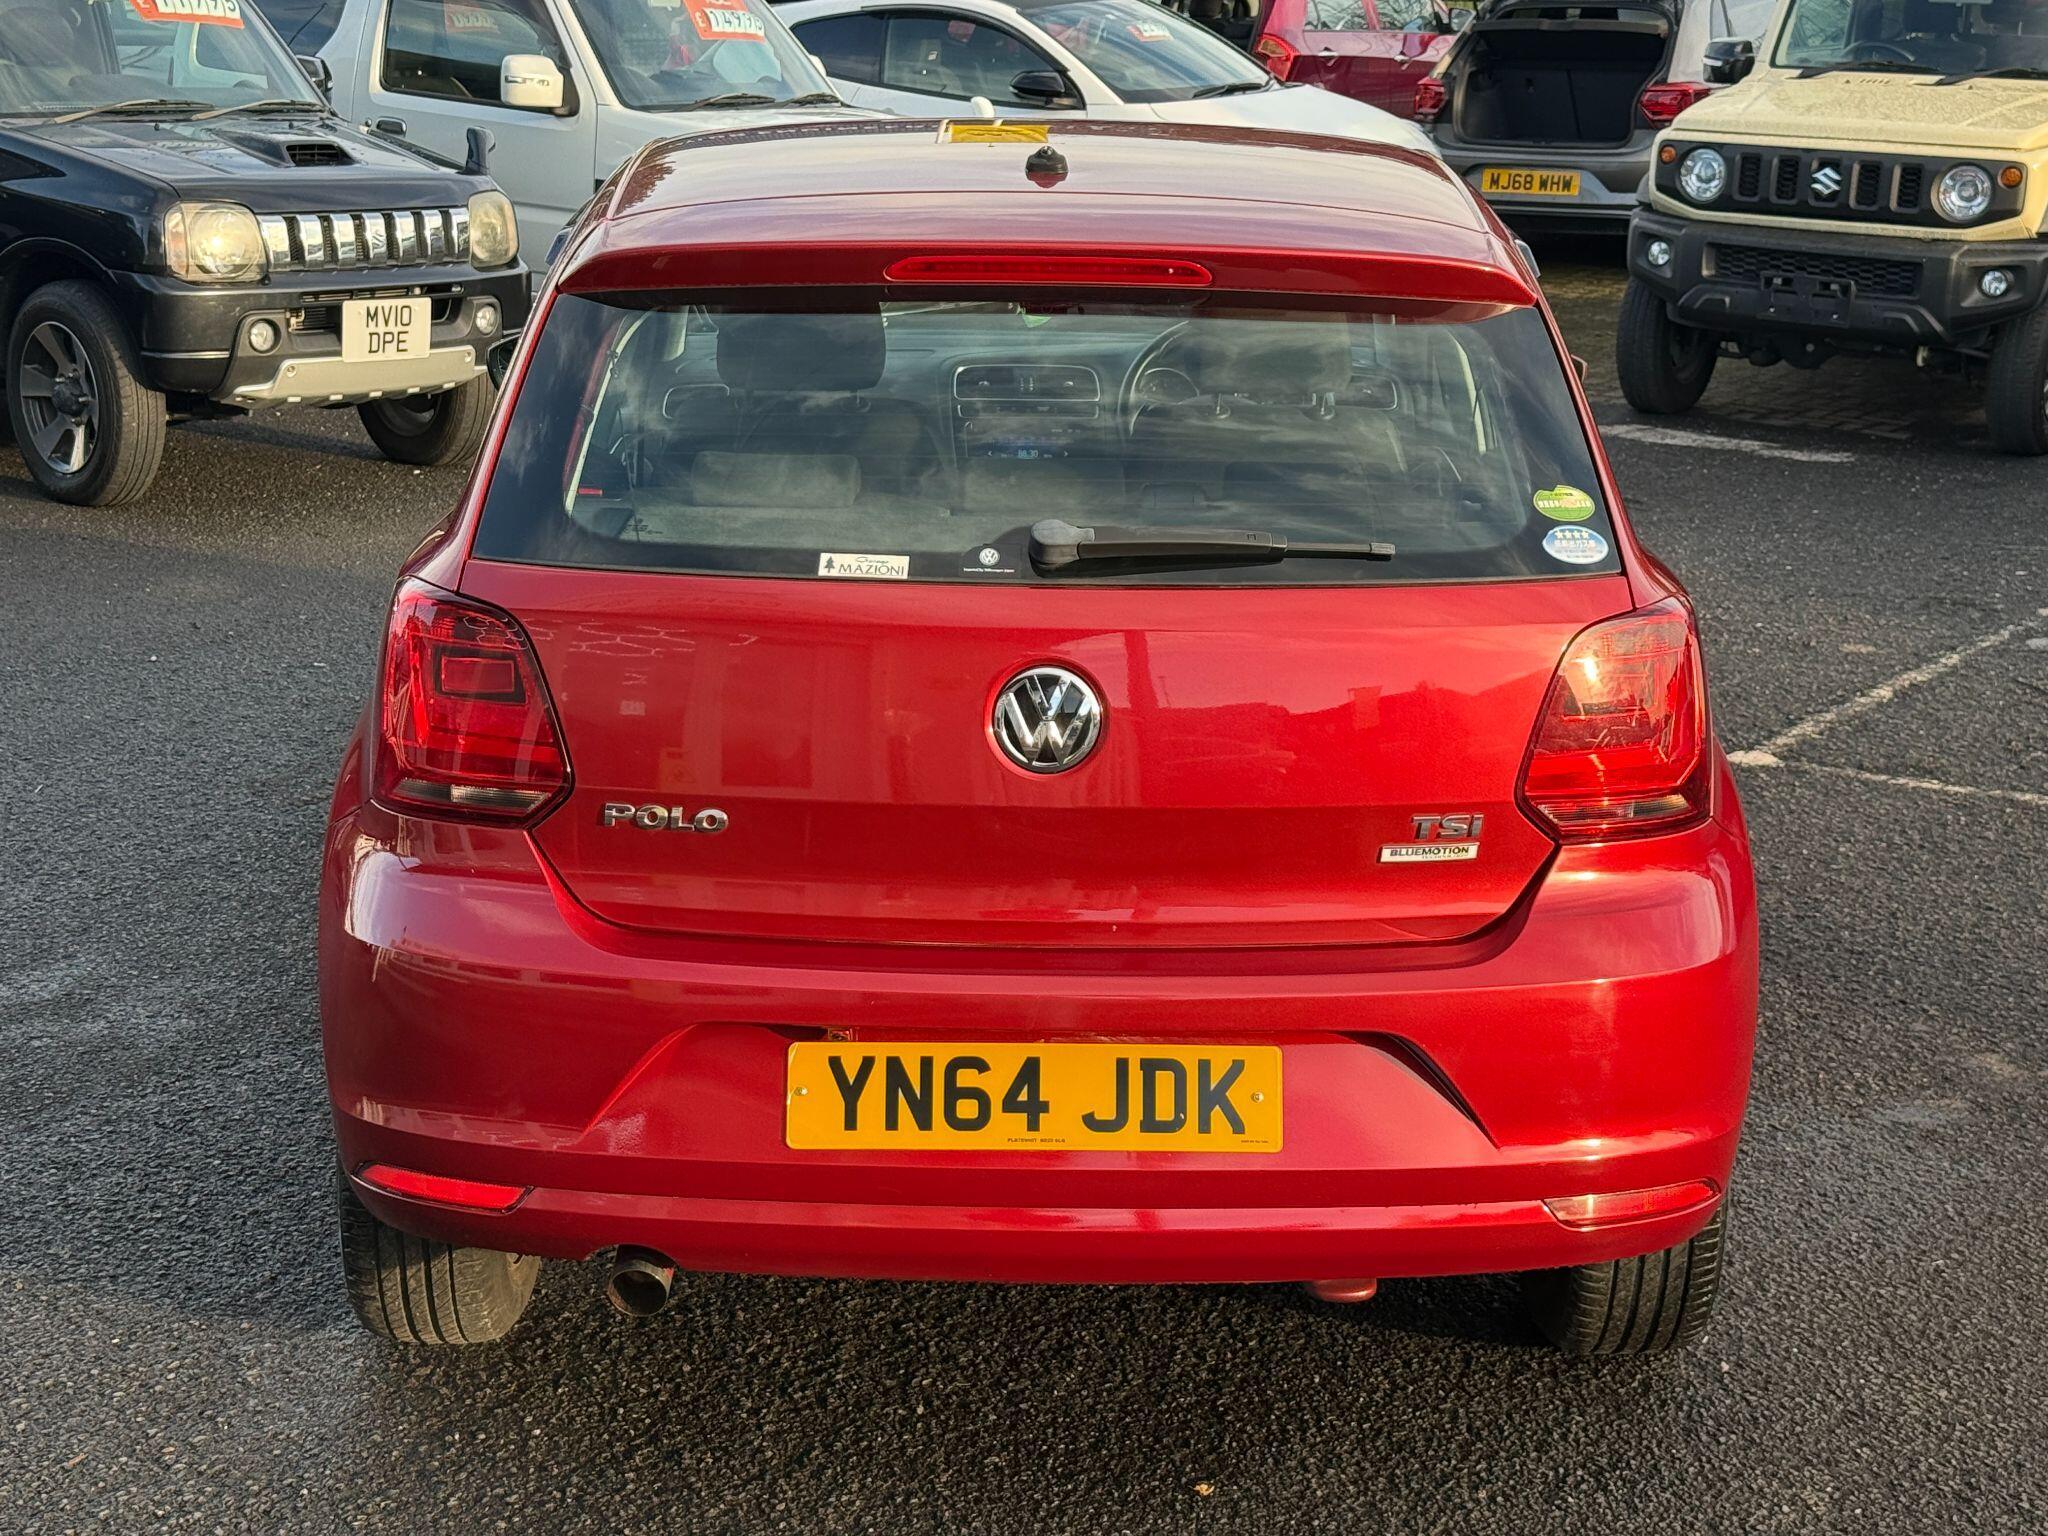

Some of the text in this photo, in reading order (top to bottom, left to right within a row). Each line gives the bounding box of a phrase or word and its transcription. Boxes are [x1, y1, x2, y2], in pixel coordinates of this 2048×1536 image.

[1489, 172, 1573, 192] MJ68 WHW
[366, 305, 412, 328] MV10
[368, 331, 409, 354] DPE
[839, 563, 904, 575] MAZIONI
[604, 802, 729, 832] POLO
[1412, 814, 1484, 840] TSI
[1390, 847, 1469, 857] BLUEMOTION
[827, 1056, 1246, 1135] YN64 JDK
